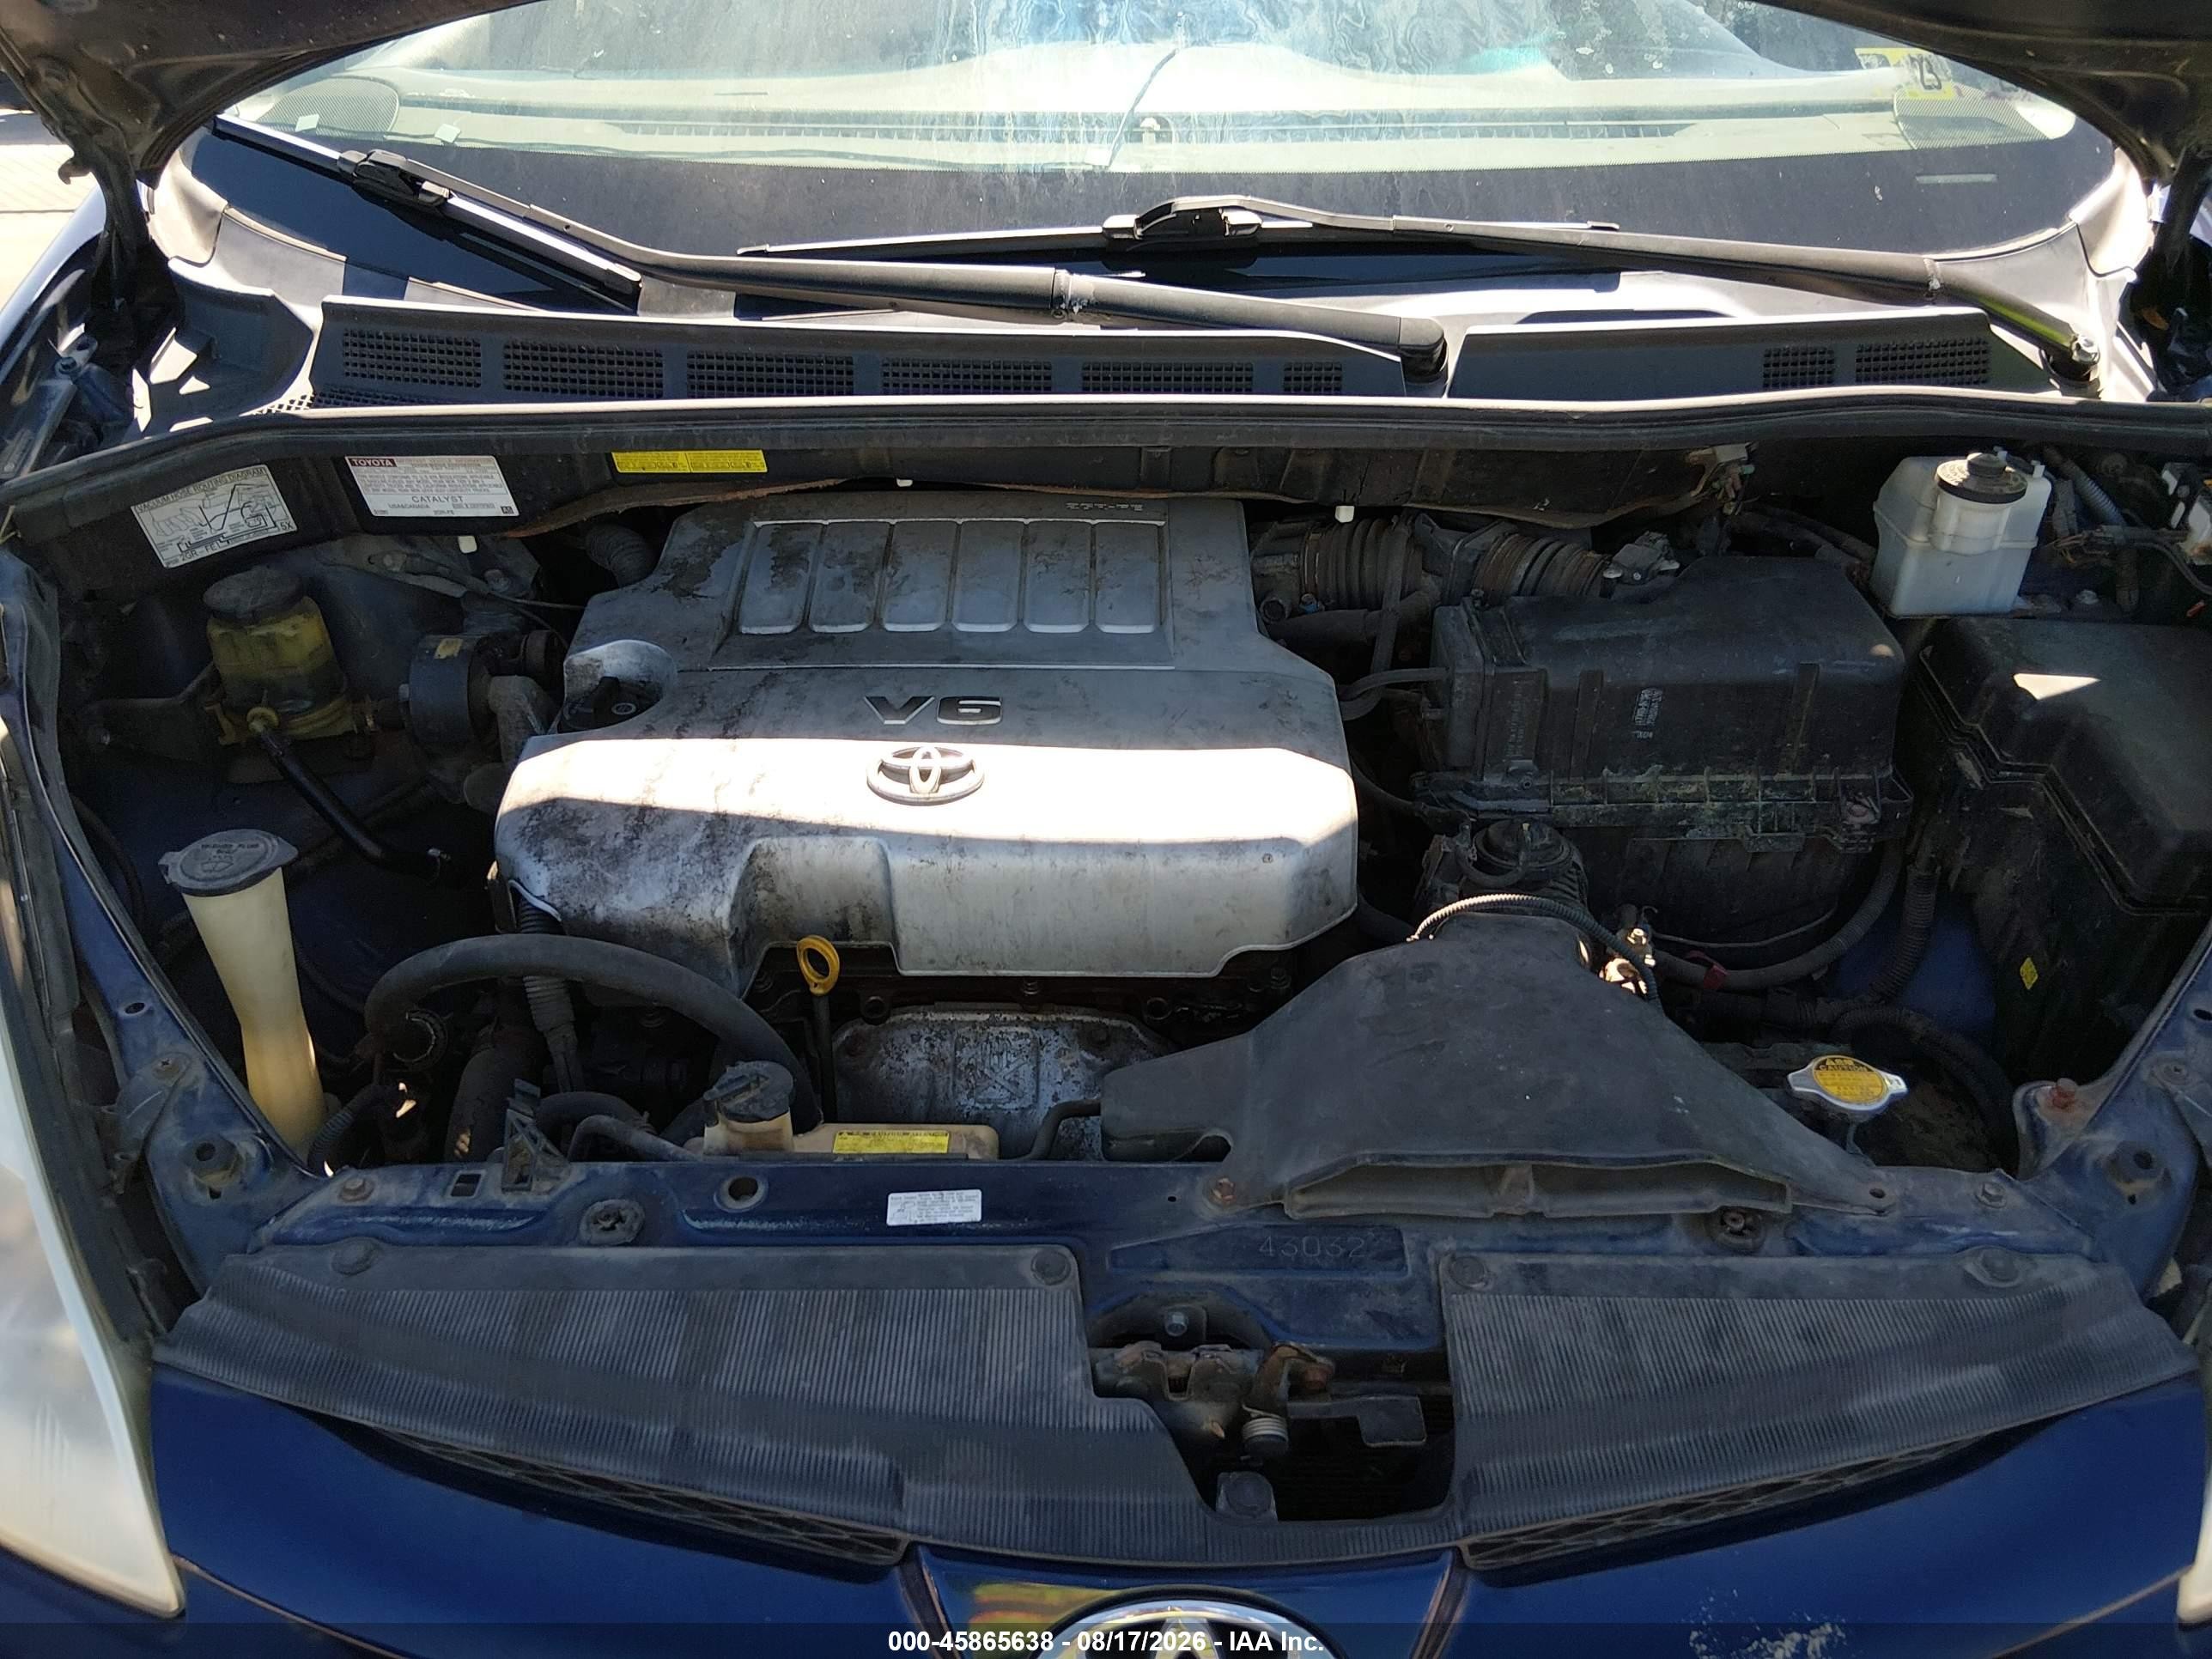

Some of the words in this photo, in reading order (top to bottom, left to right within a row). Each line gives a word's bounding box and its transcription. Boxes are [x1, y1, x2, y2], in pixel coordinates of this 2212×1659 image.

[350, 459, 394, 467] TOYOTA
[137, 495, 173, 513] VACUUM
[193, 475, 229, 494] ROUTING
[228, 467, 265, 483] DIAGRAM
[411, 495, 465, 503] CATALYST
[278, 520, 295, 532] 5X
[864, 696, 1002, 726] V6
[1258, 1235, 1366, 1258] 43032
